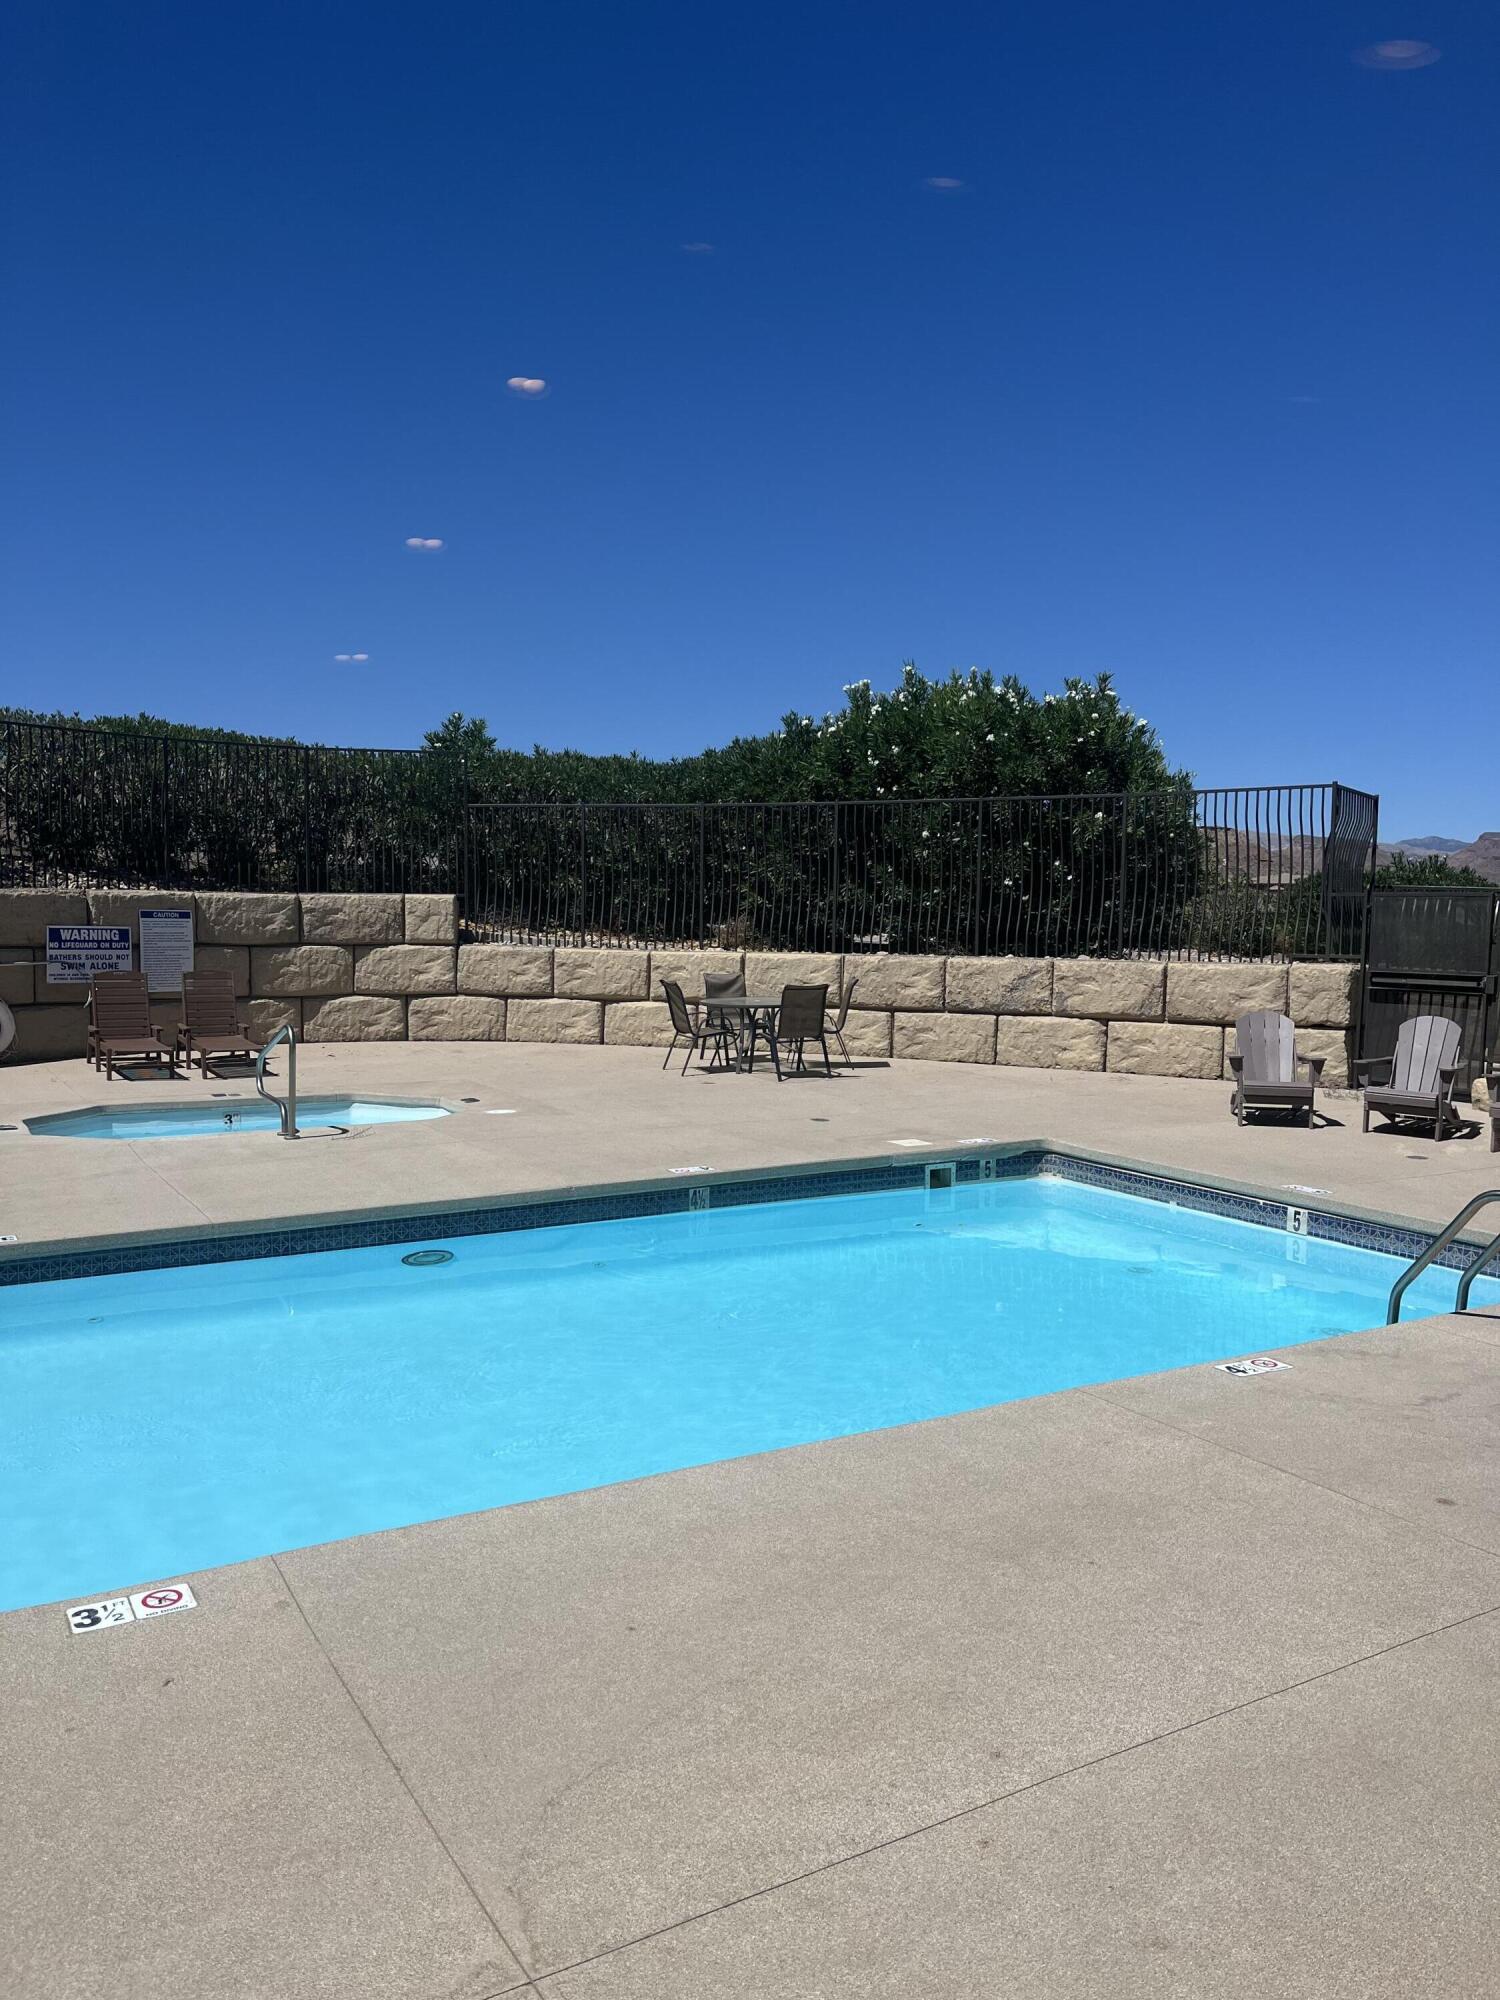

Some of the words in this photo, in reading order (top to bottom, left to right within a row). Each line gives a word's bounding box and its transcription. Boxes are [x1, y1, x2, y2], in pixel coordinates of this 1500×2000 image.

[60, 929, 120, 941] WARNING
[49, 953, 82, 961] BATHERS
[85, 953, 113, 961] SHOULD
[116, 953, 130, 961] NOT
[60, 962, 86, 971] SWIM
[89, 962, 120, 970] ALONE
[224, 1113, 233, 1125] 3
[984, 1160, 992, 1178] 5
[1293, 1209, 1302, 1232] 5
